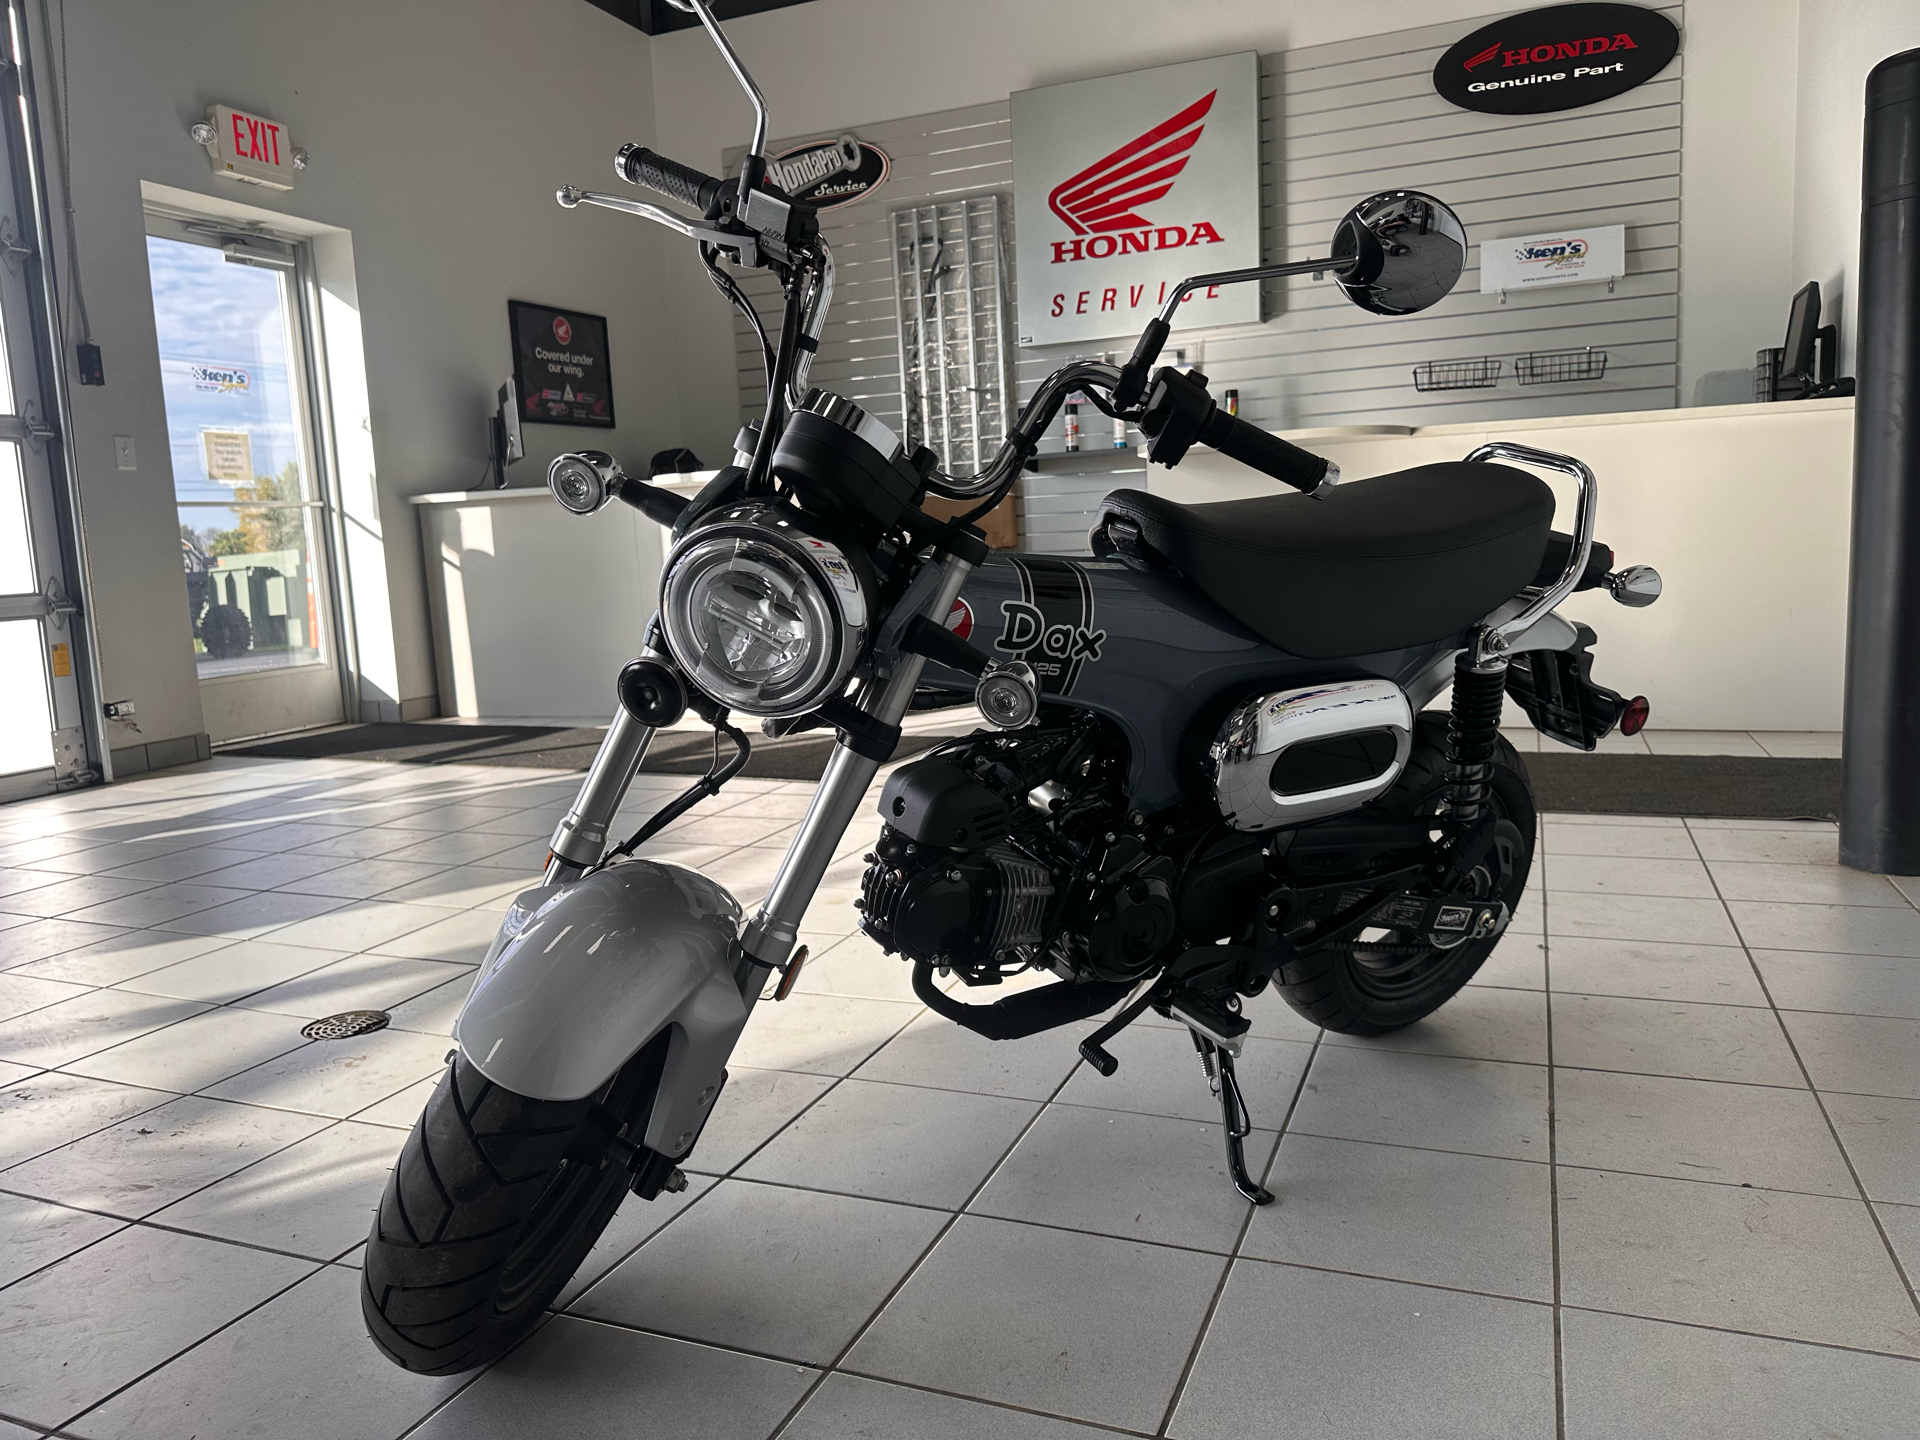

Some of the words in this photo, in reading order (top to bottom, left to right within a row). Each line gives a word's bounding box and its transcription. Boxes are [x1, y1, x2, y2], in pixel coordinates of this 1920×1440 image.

[1502, 33, 1638, 68] HONDA
[1467, 71, 1566, 92] Genuine
[1573, 62, 1624, 78] Part
[232, 113, 280, 166] EXIT
[767, 149, 842, 194] HondaPro
[814, 180, 868, 197] Service
[1050, 222, 1225, 264] HONDA
[1051, 281, 1220, 318] SERVIE
[535, 347, 570, 362] Covered
[571, 353, 594, 366] under
[548, 362, 562, 373] our
[563, 365, 585, 378] wing.
[994, 600, 1107, 662] Dax
